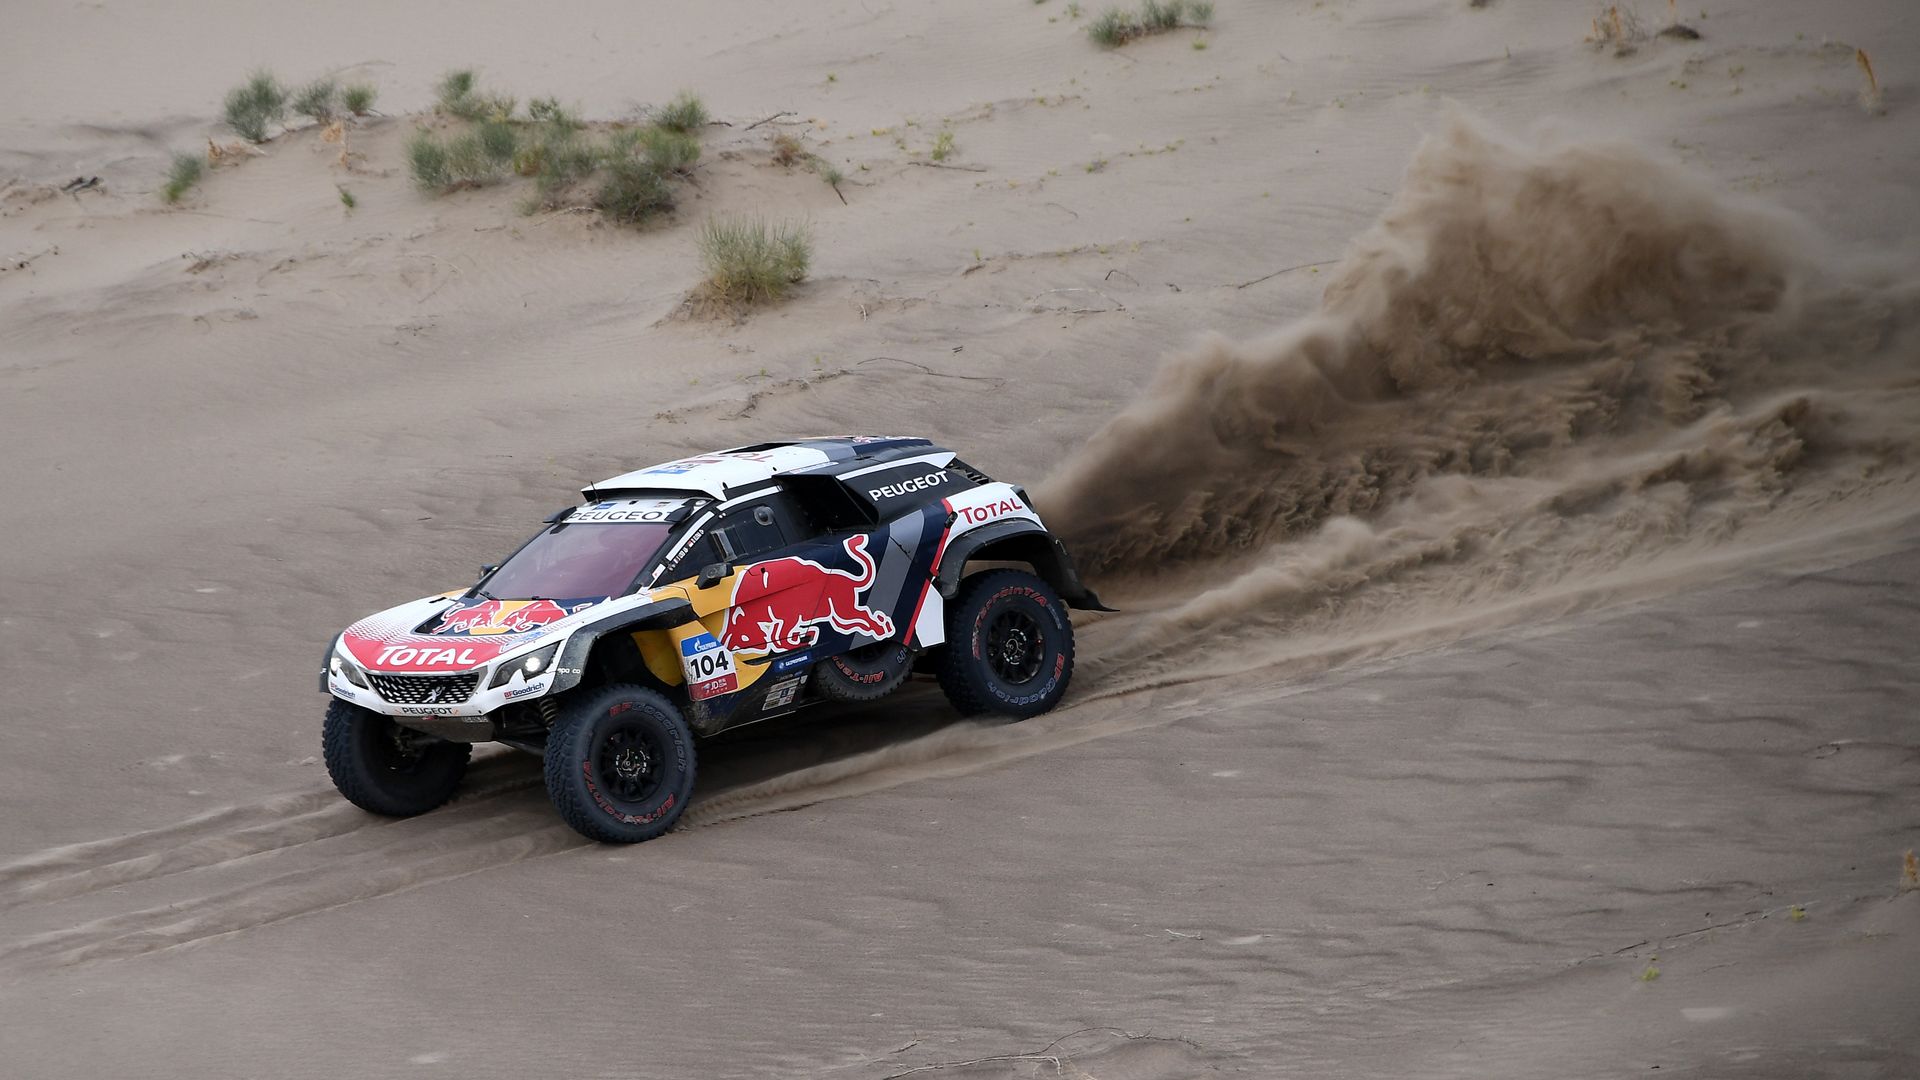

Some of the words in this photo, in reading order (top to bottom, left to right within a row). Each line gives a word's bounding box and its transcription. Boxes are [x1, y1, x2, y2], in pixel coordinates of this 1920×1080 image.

[869, 470, 949, 502] PEUGEOT
[566, 510, 673, 521] PEUGEO
[958, 498, 1023, 525] TOTAL
[375, 645, 477, 666] TOTAL
[690, 650, 730, 679] 104
[503, 682, 545, 698] BFGoodrich
[401, 707, 453, 715] PEUGEOT
